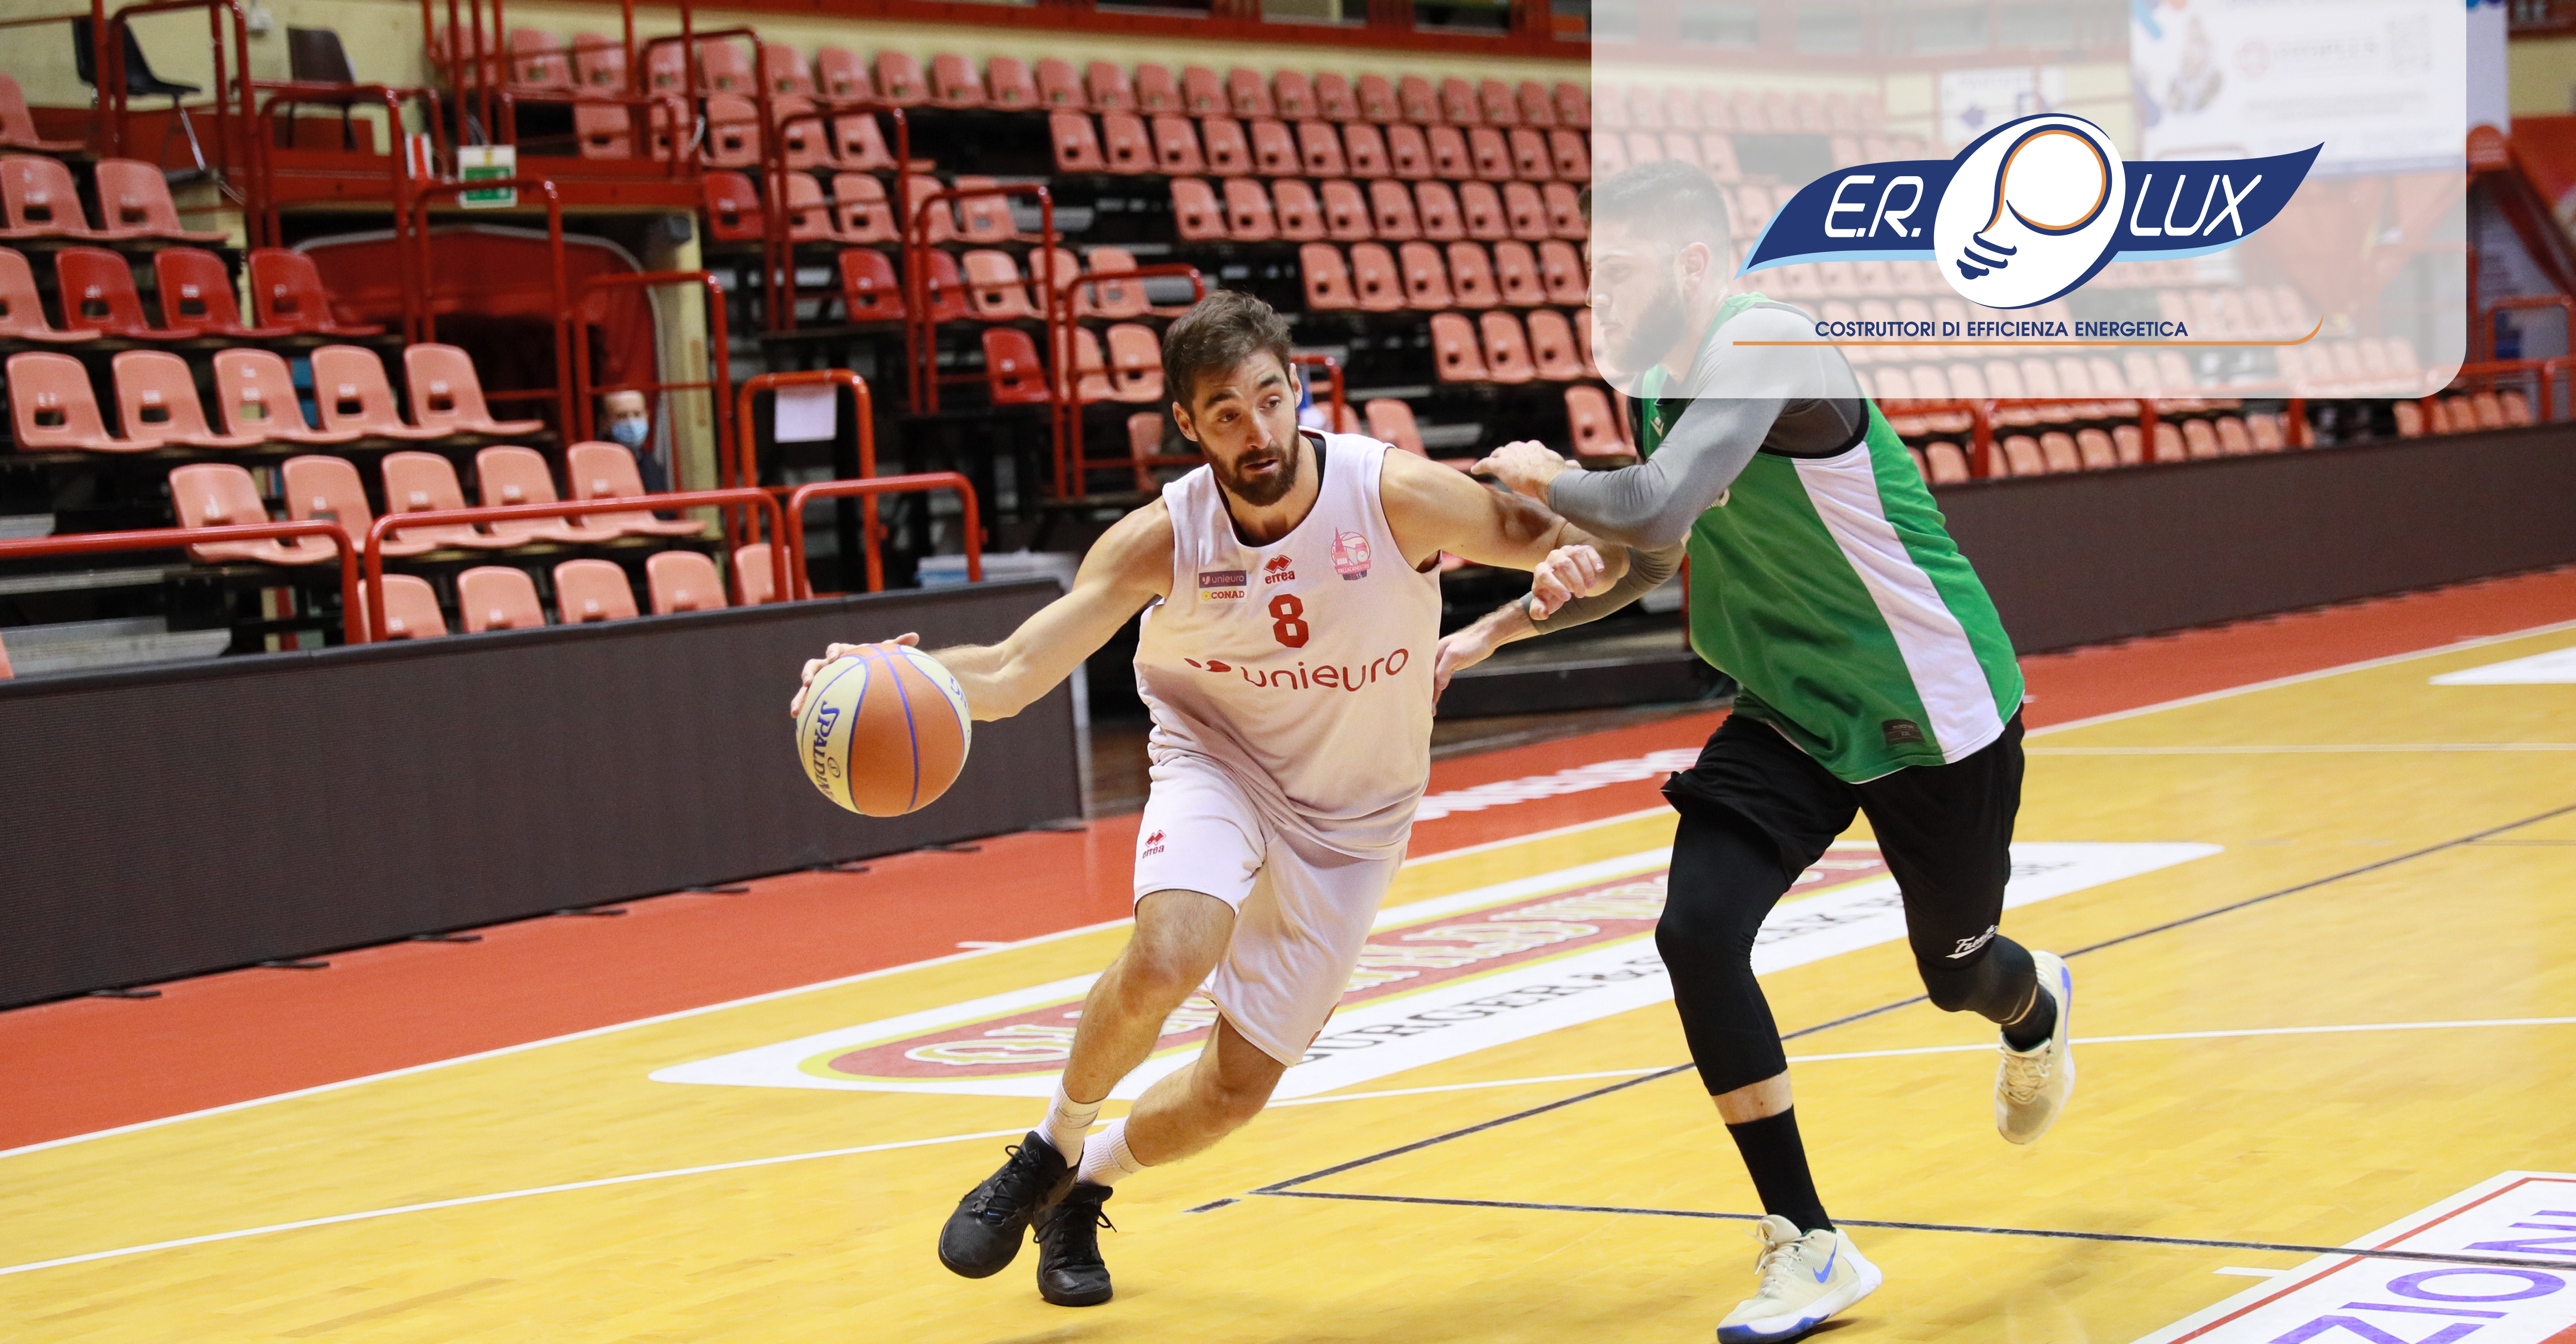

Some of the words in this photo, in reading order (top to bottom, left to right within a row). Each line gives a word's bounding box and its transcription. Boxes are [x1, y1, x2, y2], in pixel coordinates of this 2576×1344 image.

[1337, 564, 1370, 574] PALLACANESTRO
[1211, 574, 1245, 584] unieuro
[1265, 570, 1295, 585] errea
[1211, 590, 1245, 600] CONAD
[1268, 593, 1309, 648] 8
[1240, 648, 1409, 692] unieuro
